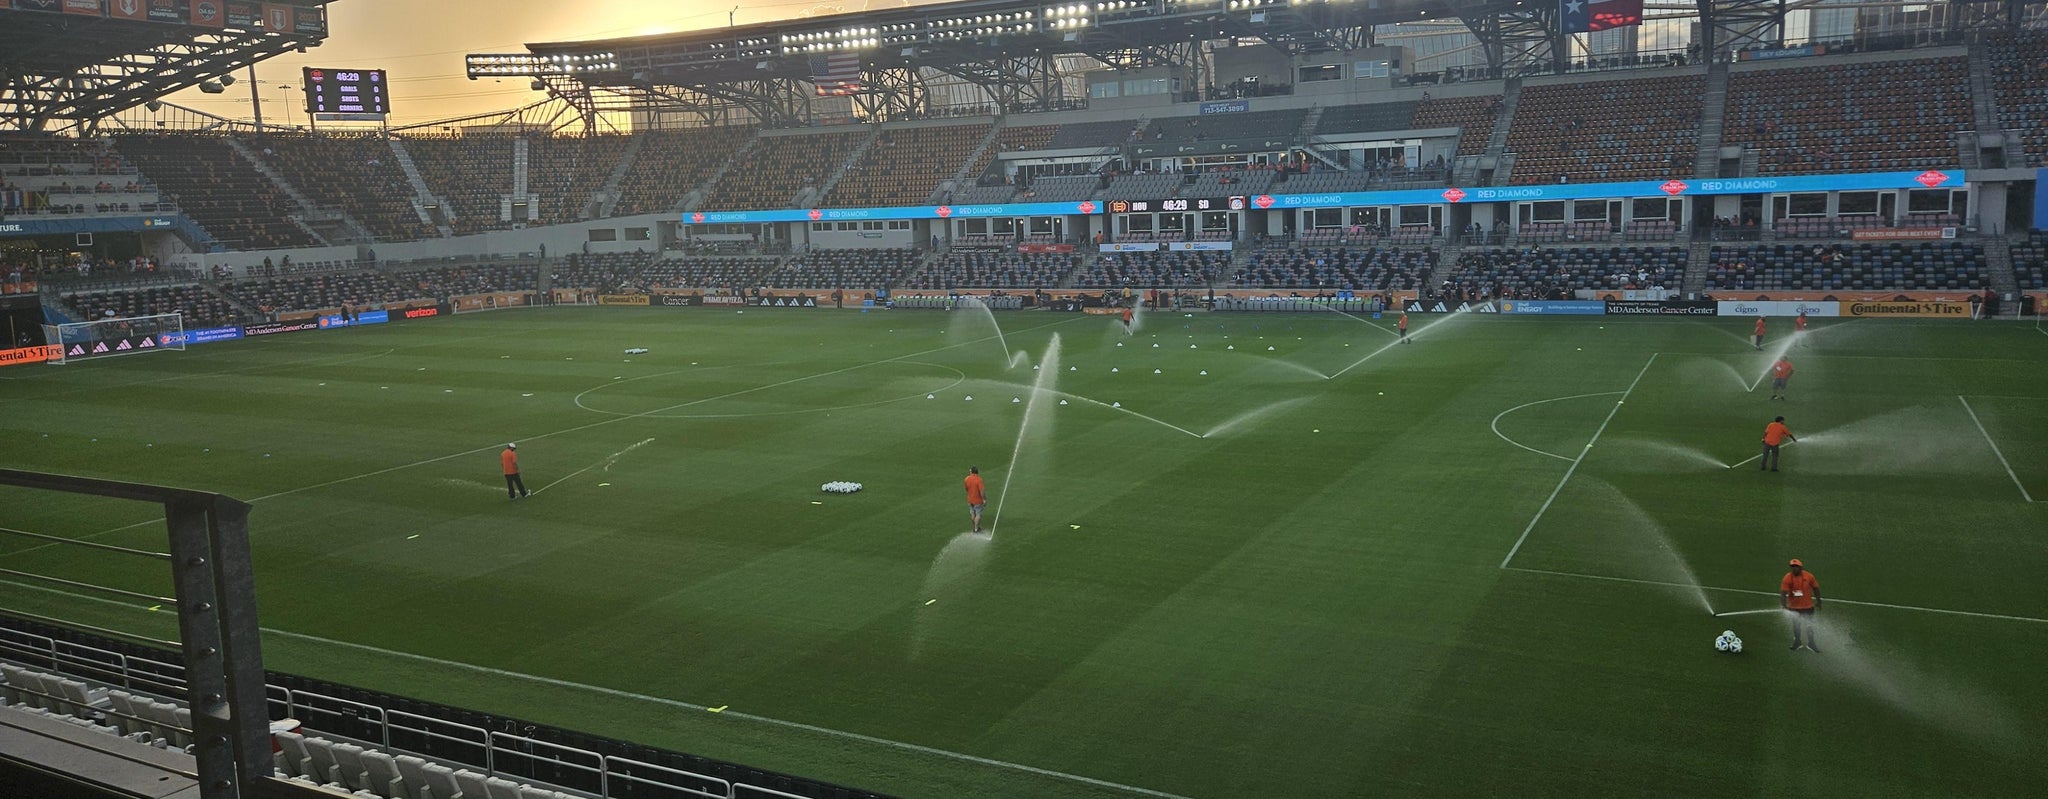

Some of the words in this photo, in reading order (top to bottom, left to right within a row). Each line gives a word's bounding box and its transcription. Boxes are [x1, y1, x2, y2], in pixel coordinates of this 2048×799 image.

[149, 10, 178, 18] CHAMPIONS
[318, 104, 325, 112] 0
[1701, 182, 1723, 190] RED
[1725, 180, 1777, 190] DIAMOND
[1477, 190, 1496, 198] RED
[1498, 188, 1543, 197] DIAMOND
[1285, 197, 1301, 205] RED
[1302, 195, 1341, 204] DIAMOND
[1132, 202, 1147, 211] HOU
[1163, 200, 1187, 211] 46:29
[1198, 200, 1209, 210] SD
[841, 210, 868, 218] DIAMOND
[662, 295, 688, 305] Cancer
[405, 308, 437, 319] verizon
[1622, 306, 1659, 314] Anderson
[1660, 306, 1687, 314] Cancer
[1851, 302, 1920, 315] Continental
[1933, 303, 1962, 314] Tire
[38, 346, 62, 357] Tire
